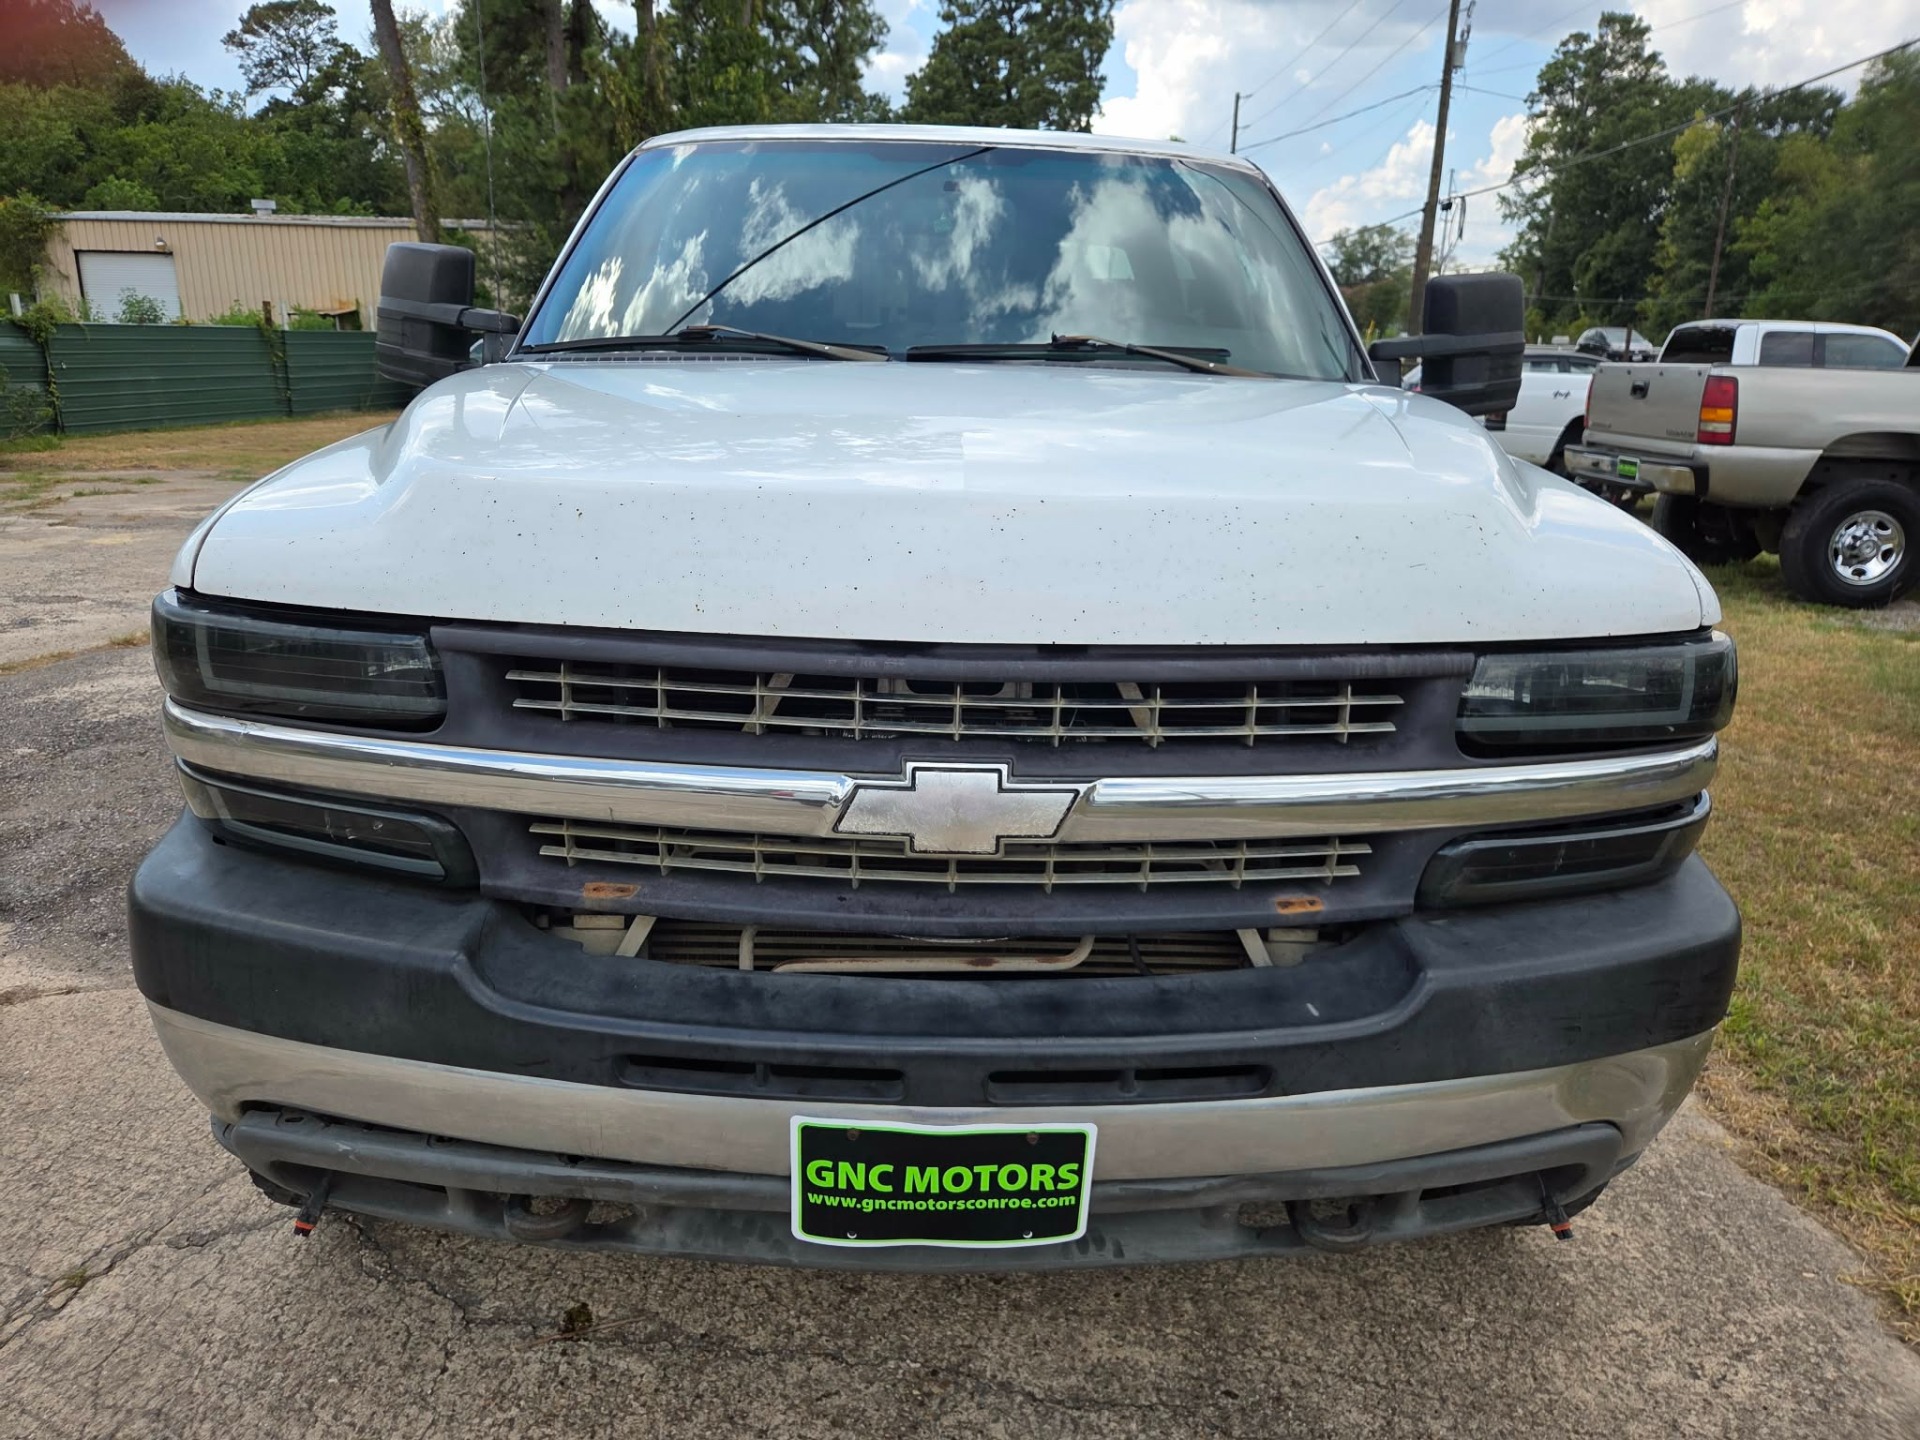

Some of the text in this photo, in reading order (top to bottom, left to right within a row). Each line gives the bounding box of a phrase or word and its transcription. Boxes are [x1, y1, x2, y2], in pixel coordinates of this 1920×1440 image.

[806, 1159, 1079, 1194] GNC MOTORS
[807, 1193, 1076, 1212] www.gncmotorsconroe.com
